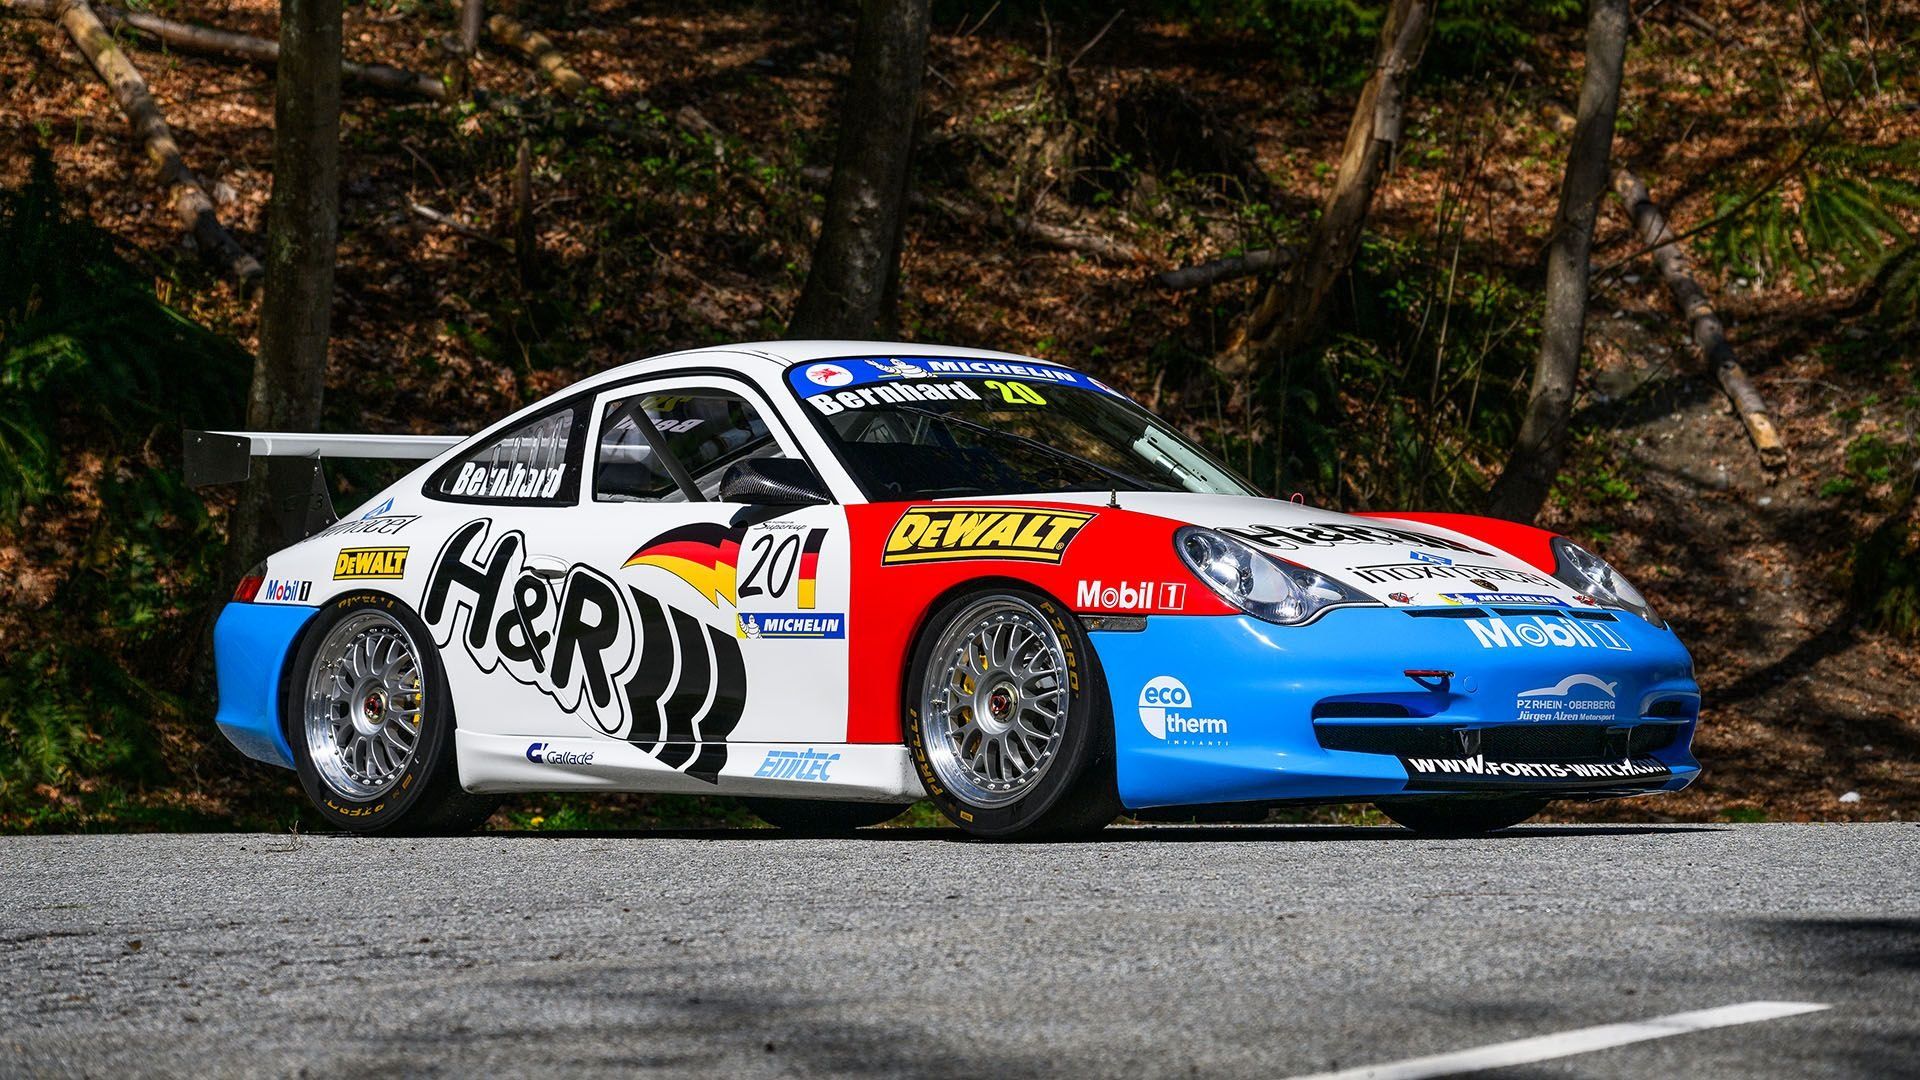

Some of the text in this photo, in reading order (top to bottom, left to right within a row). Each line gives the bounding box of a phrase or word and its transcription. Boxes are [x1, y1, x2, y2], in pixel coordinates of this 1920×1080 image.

[927, 360, 1077, 382] MICHELIN
[805, 380, 1047, 416] Bernhard 20
[450, 462, 566, 498] Bernhard
[738, 533, 800, 598] 20
[266, 580, 312, 601] Mobil 1
[1077, 580, 1154, 609] Mobil
[1476, 595, 1560, 604] MICHELIN
[421, 518, 630, 726] H&R
[763, 618, 839, 632] MICHELIN
[1464, 616, 1598, 648] Mobil
[1144, 686, 1186, 705] eco
[1517, 700, 1531, 709] PZ
[1532, 700, 1561, 709] RHEIN
[1568, 701, 1616, 710] OBERBERG
[1166, 713, 1228, 733] therm
[1517, 710, 1616, 723] Jürgen Alzen Motorsport
[910, 708, 944, 795] PIRELLI
